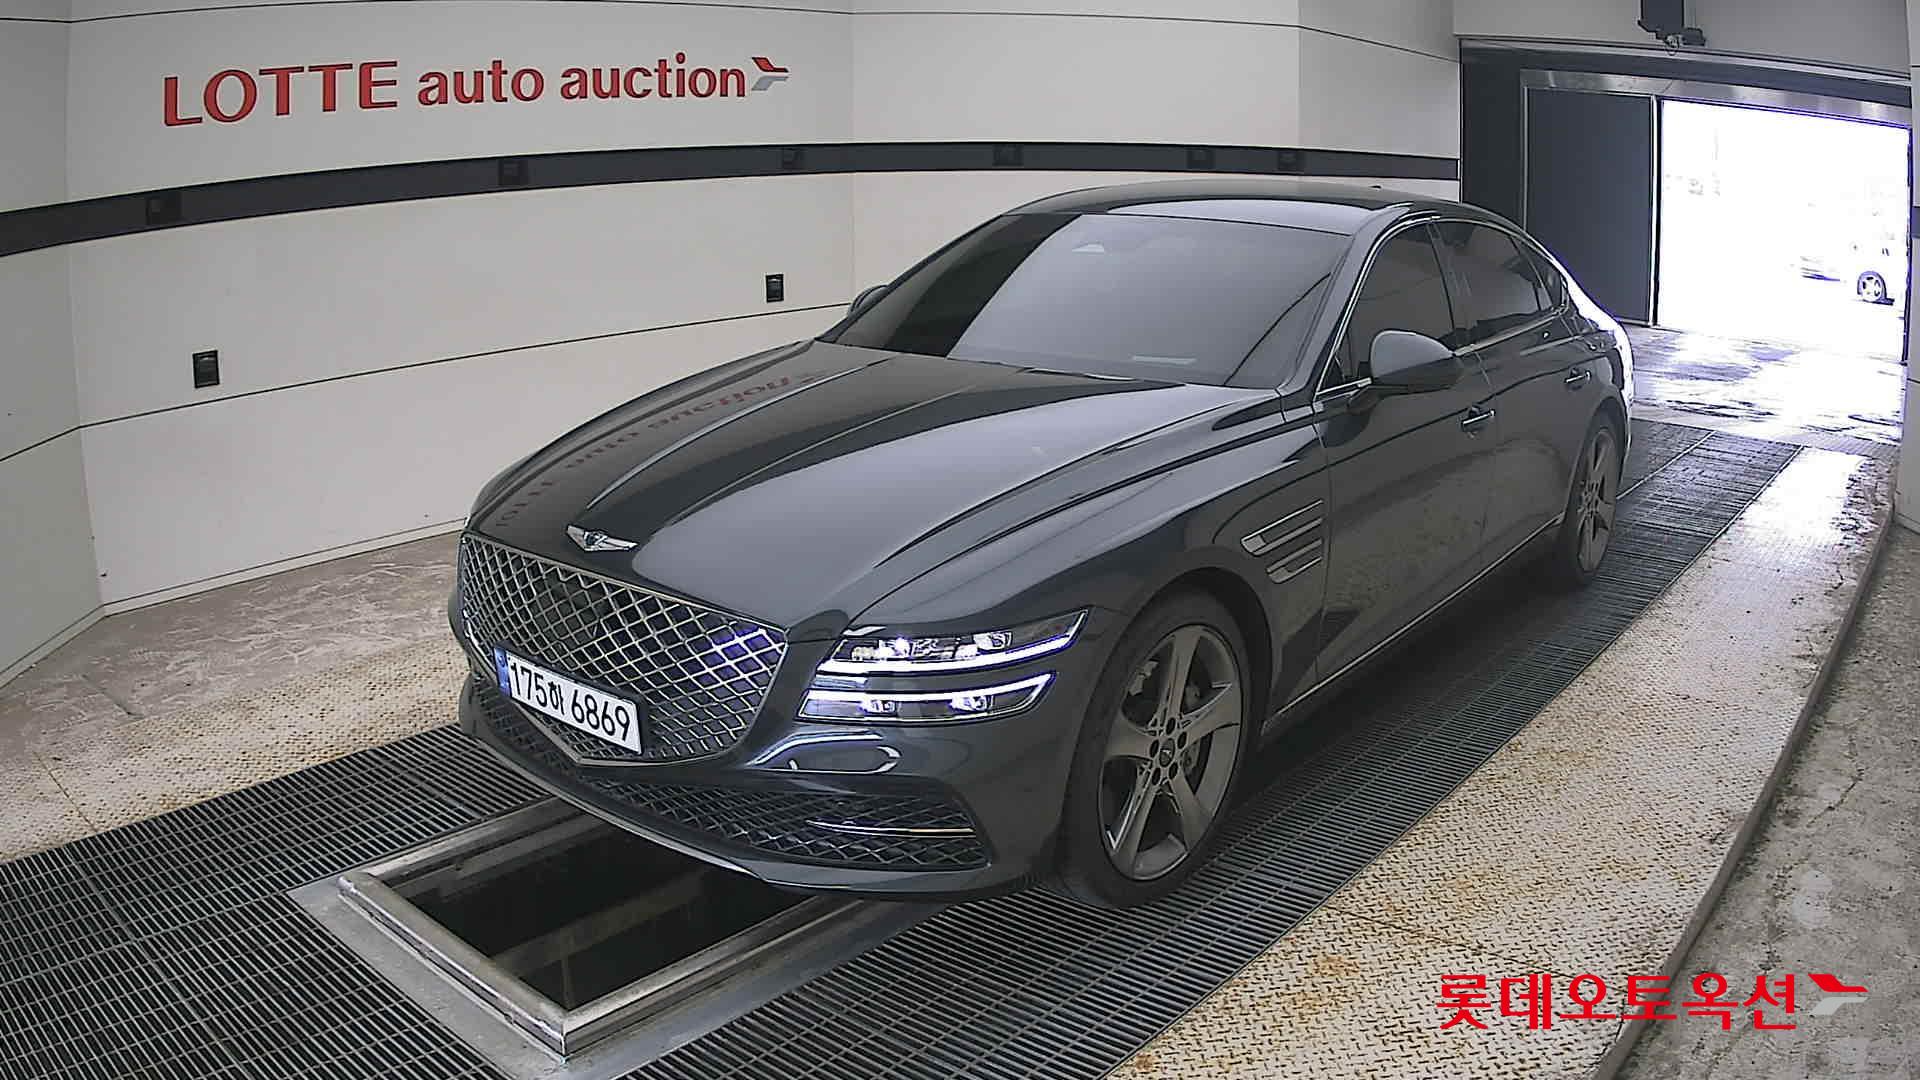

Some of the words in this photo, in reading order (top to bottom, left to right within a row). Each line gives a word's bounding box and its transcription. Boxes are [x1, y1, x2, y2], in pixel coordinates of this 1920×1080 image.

[164, 61, 398, 127] LOTTE
[418, 60, 545, 106] auto
[560, 52, 746, 101] auction
[571, 689, 631, 742] 6869
